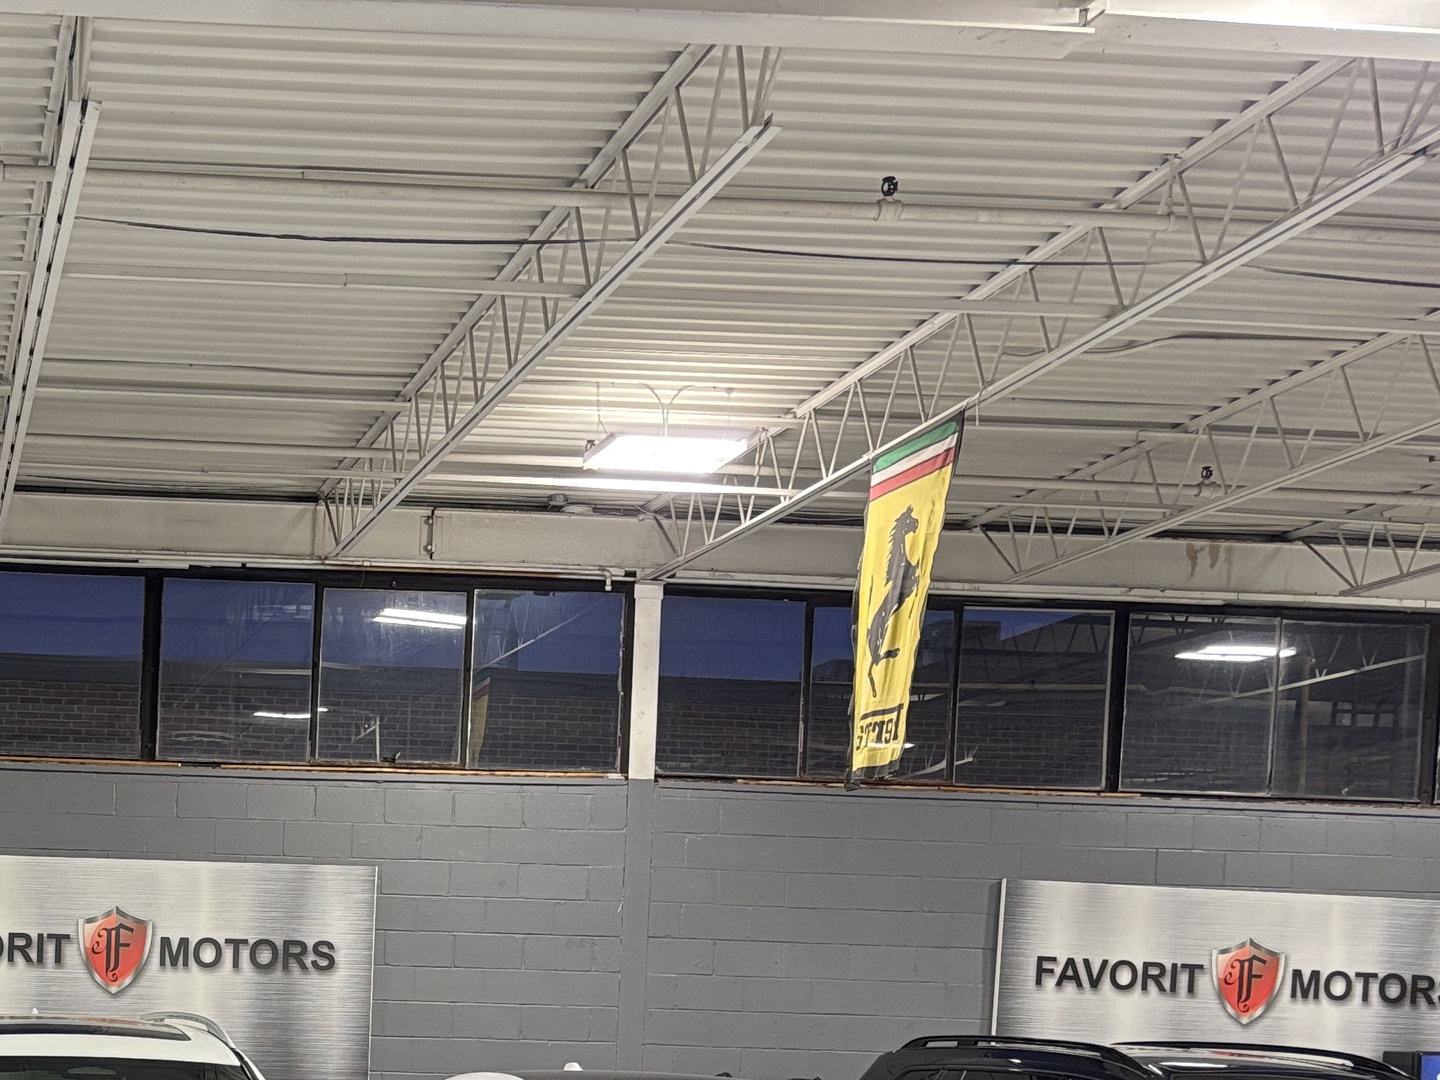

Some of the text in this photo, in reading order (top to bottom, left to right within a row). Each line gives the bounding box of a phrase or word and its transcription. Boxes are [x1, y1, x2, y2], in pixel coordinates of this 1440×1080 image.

[160, 936, 336, 971] MOTORS
[1034, 955, 1204, 994] FAVORIT
[1290, 969, 1440, 1006] MOTOR
